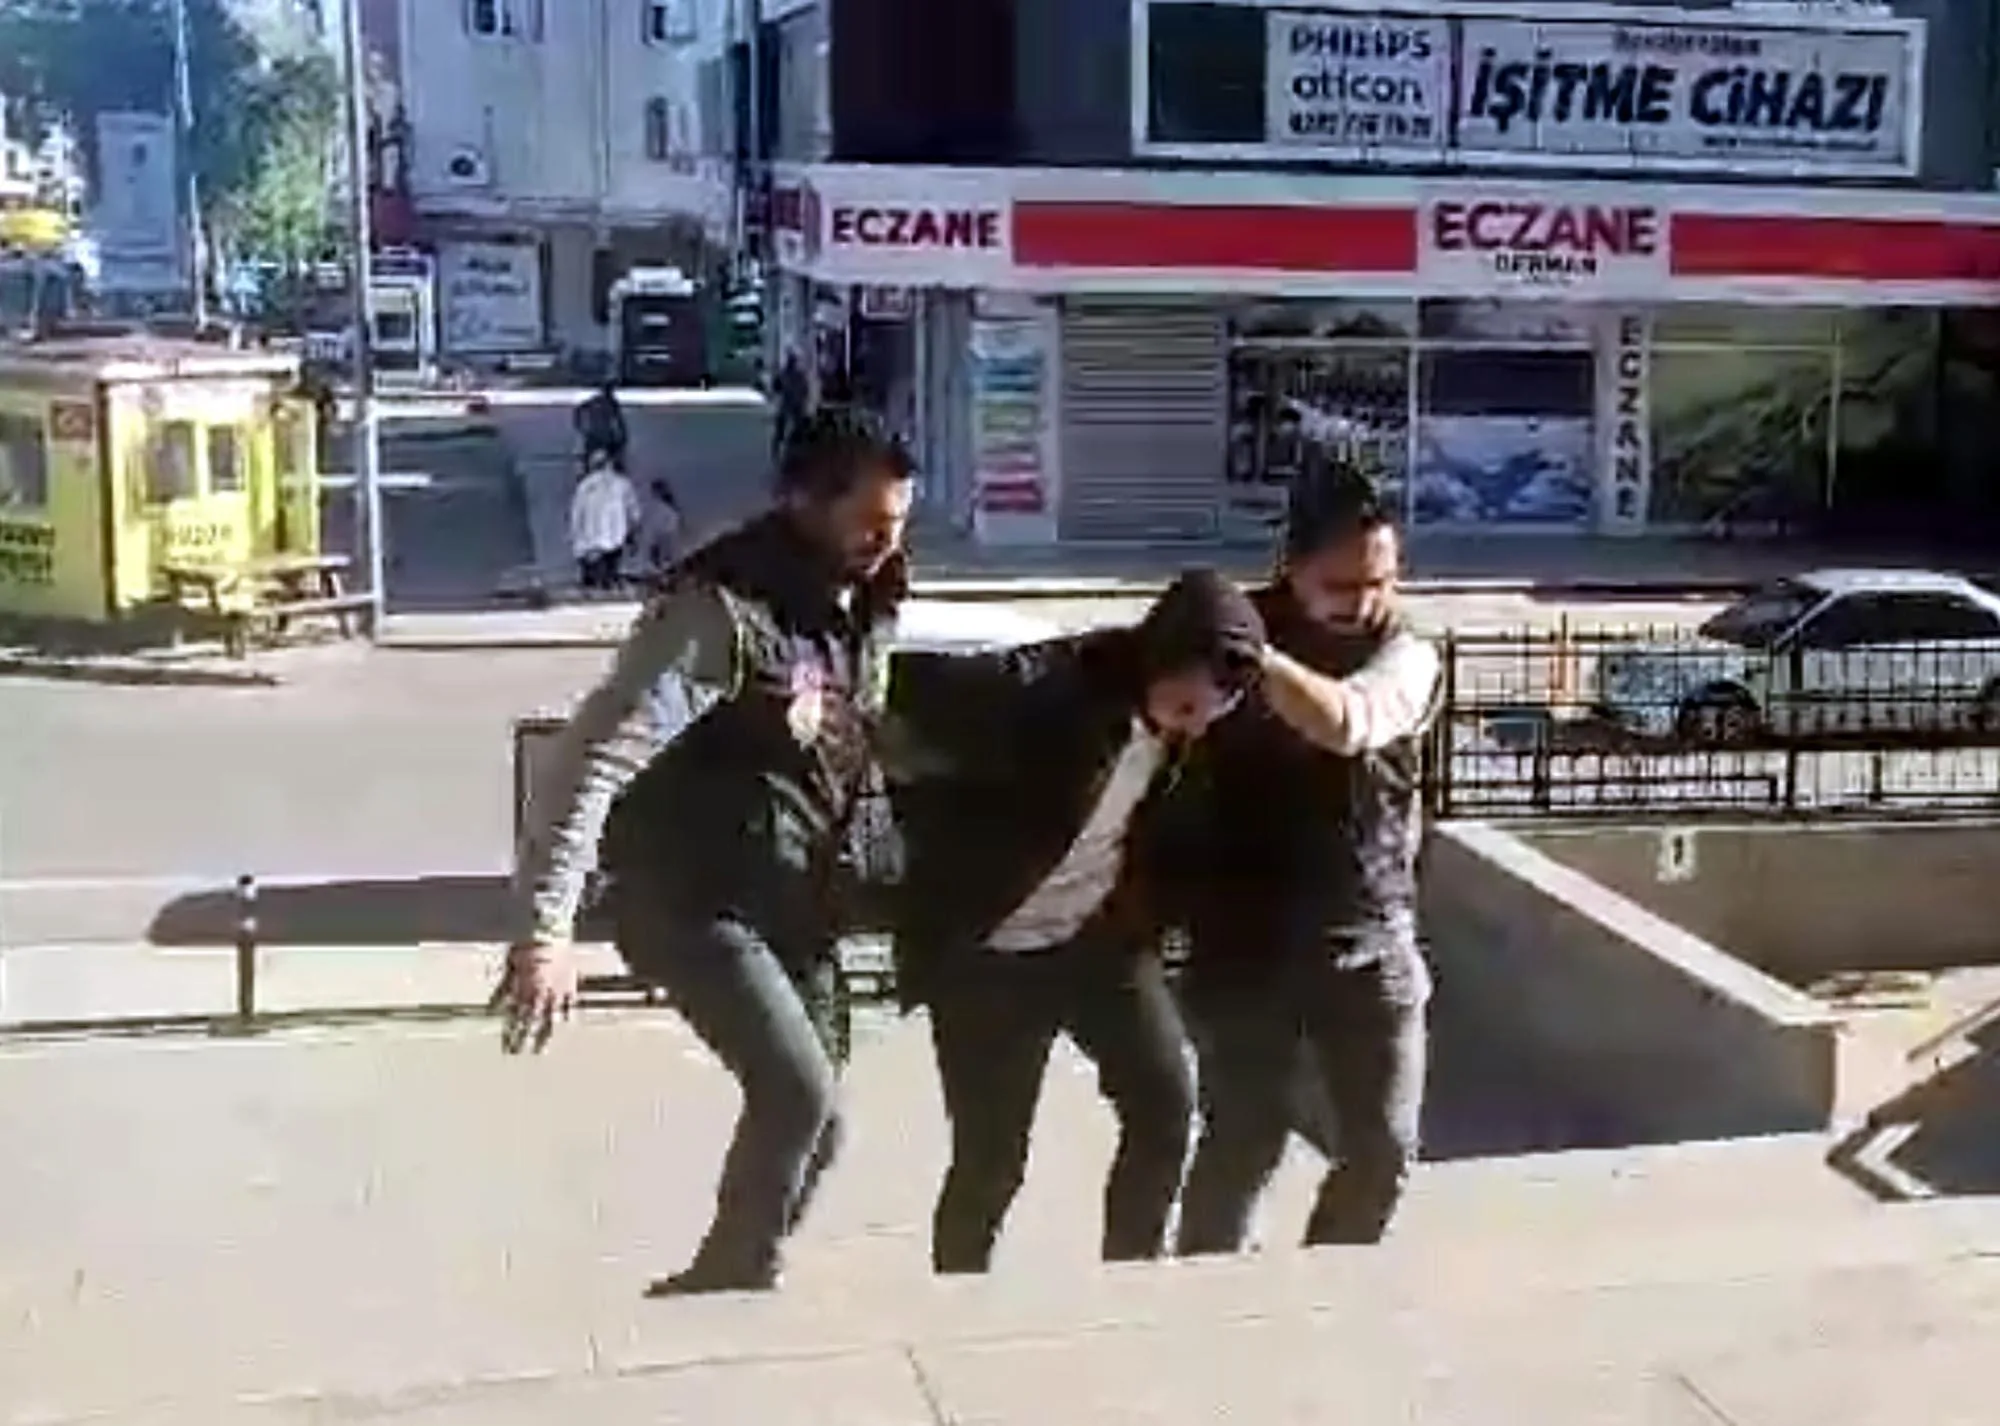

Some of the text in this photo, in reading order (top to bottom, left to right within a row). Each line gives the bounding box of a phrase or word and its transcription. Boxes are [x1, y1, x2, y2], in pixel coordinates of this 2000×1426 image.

[1292, 63, 1425, 103] oticon
[1470, 46, 1677, 133] İŞİTME
[833, 207, 1001, 248] ECZANE
[1434, 201, 1658, 255] ECZANE
[1615, 314, 1643, 521] ECZANE
